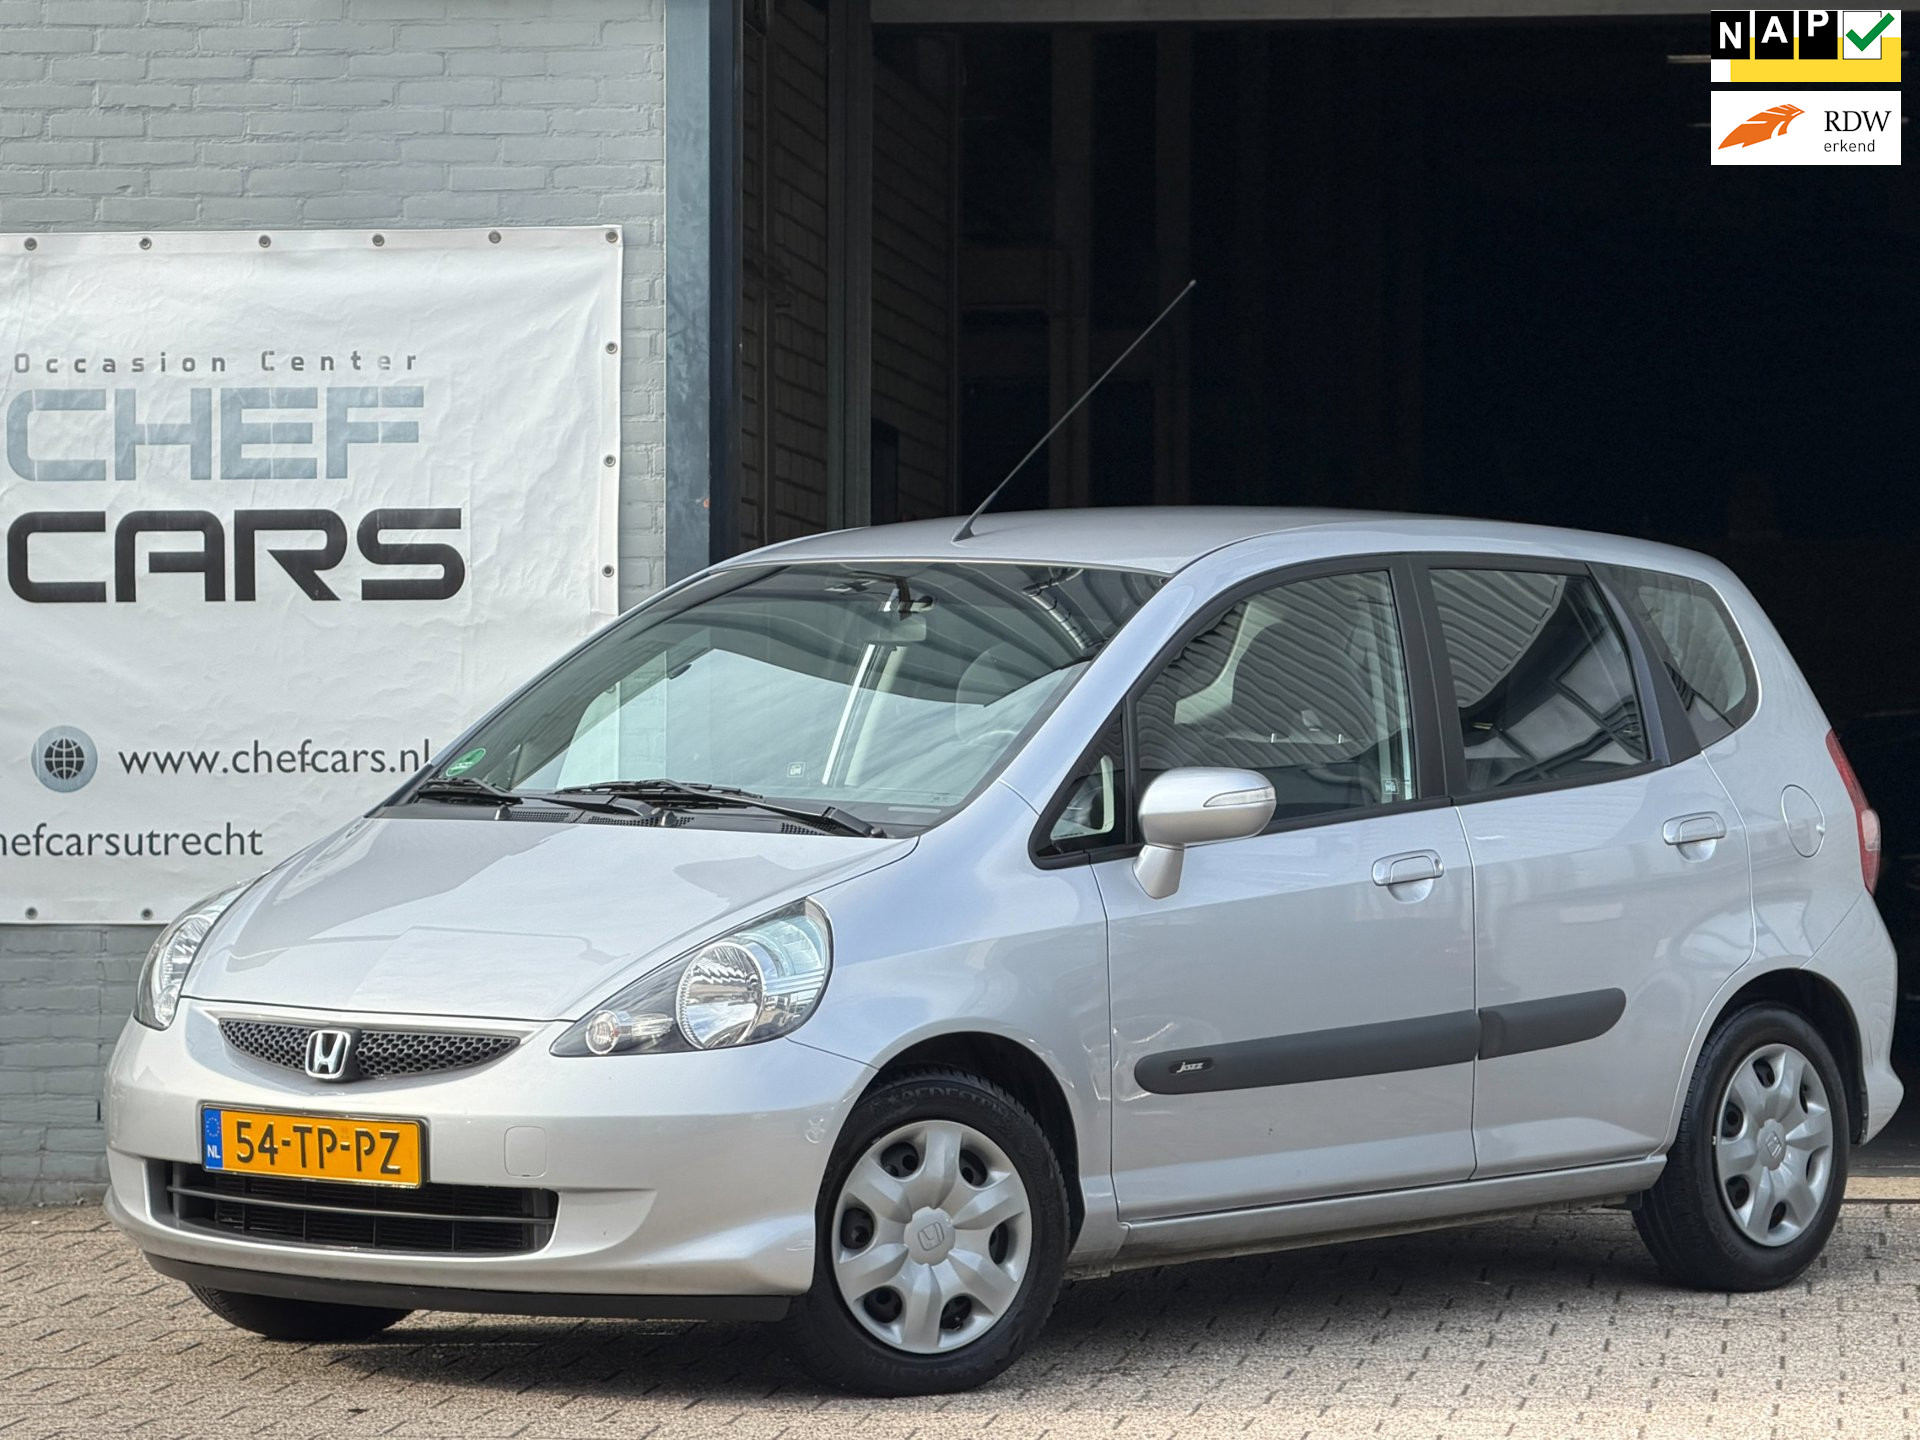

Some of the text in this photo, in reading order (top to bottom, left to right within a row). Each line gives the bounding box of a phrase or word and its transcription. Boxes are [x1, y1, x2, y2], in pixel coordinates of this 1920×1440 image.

[14, 350, 417, 374] Occasion Center
[6, 386, 425, 481] CHEF
[7, 508, 466, 603] CARS
[118, 738, 430, 774] www.chefcars.nl
[207, 1144, 221, 1159] NL
[236, 1120, 401, 1175] 54-TP-PZ
